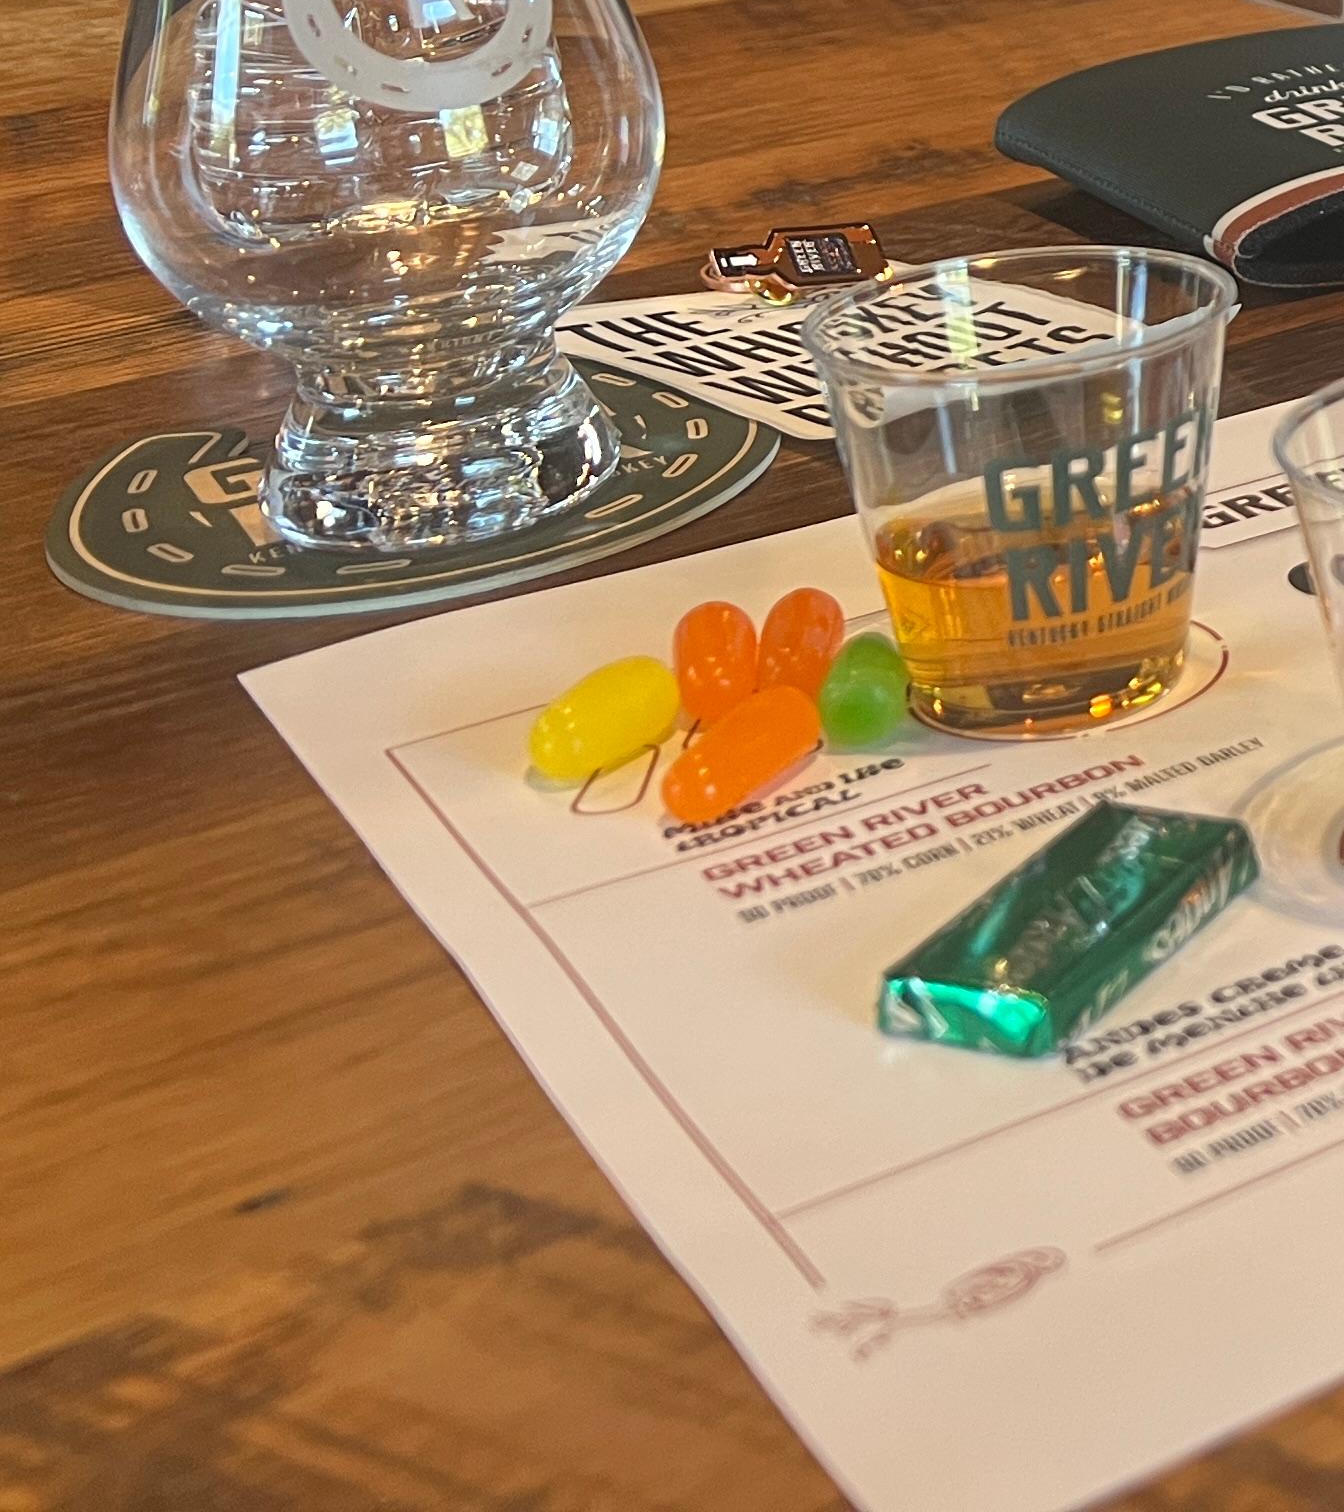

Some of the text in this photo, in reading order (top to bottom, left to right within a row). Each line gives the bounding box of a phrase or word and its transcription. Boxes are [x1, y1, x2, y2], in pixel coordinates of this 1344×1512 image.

[555, 311, 732, 353] THE
[1125, 761, 1198, 791] MALTED
[702, 782, 989, 881] GREEN RIVER
[717, 754, 1145, 899] WHEATED BOURBON
[1118, 1044, 1283, 1119] GREEN
